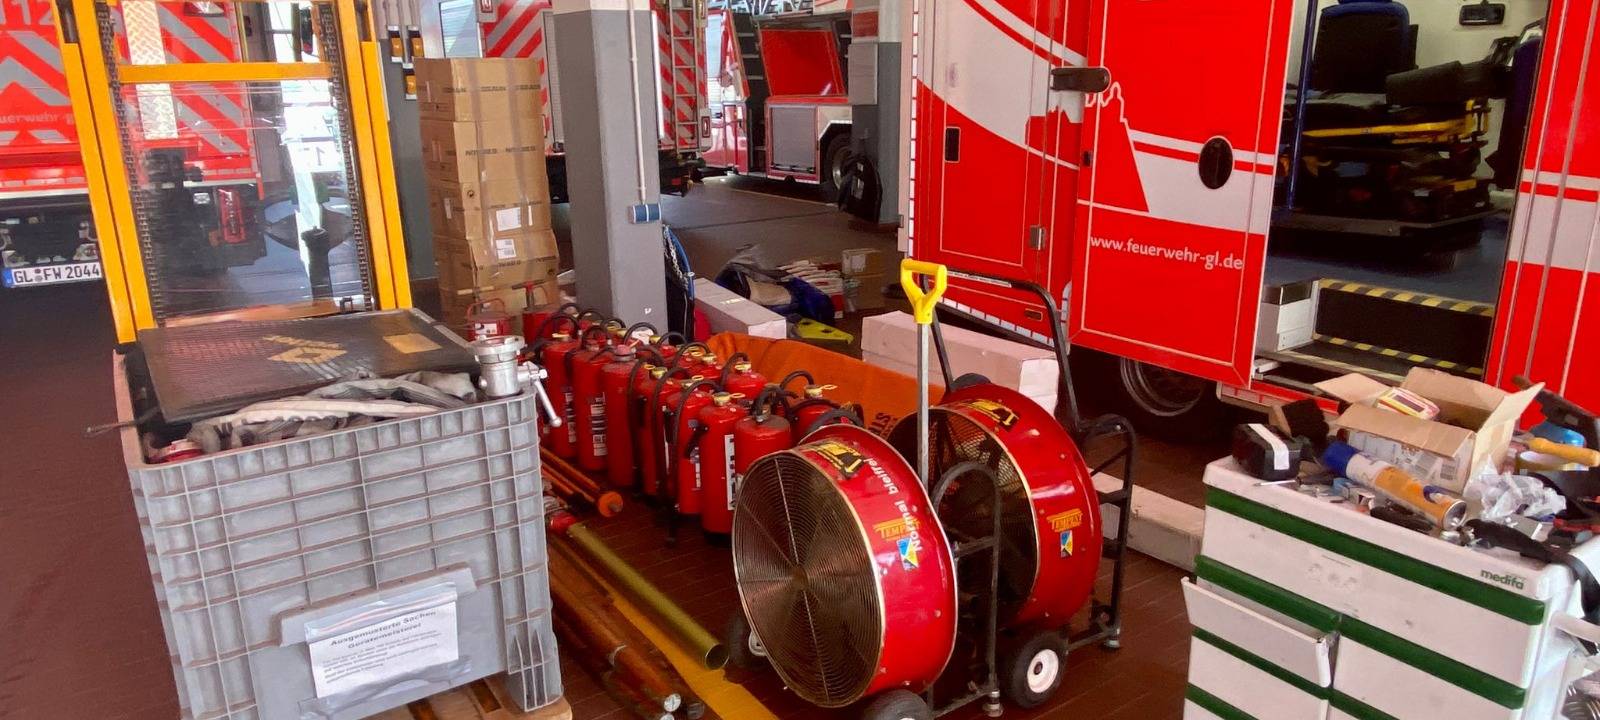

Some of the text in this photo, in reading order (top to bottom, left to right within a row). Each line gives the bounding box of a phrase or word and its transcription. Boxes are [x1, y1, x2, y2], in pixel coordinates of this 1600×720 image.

[1090, 236, 1243, 270] www.feuerwehr-gl.de
[14, 264, 100, 283] GL FW 2044
[894, 500, 923, 551] Normal
[1481, 569, 1524, 590] medifa
